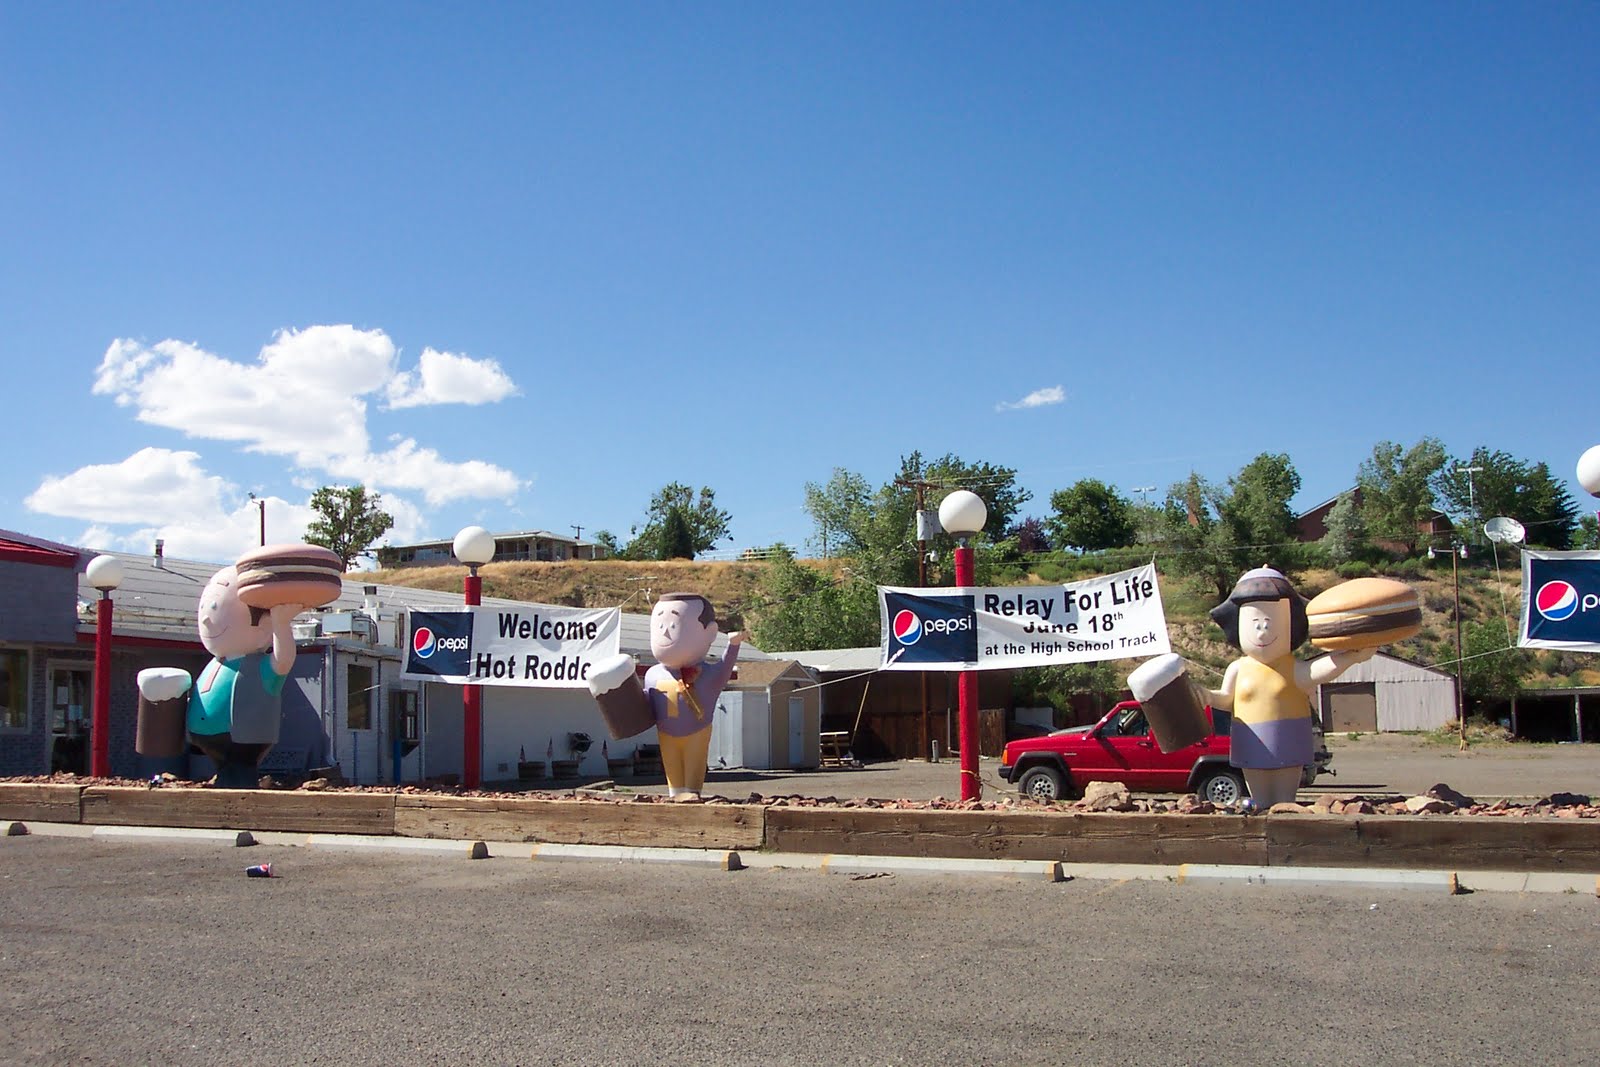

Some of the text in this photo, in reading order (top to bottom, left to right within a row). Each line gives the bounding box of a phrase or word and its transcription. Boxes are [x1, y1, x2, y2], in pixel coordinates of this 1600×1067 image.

[984, 576, 1153, 620] Relay For Life
[498, 612, 597, 640] Welcome
[924, 615, 972, 636] pepsi
[1023, 621, 1078, 634] June
[437, 635, 468, 651] pepsi
[985, 631, 1157, 656] at the High School Track
[475, 652, 516, 679] Hot
